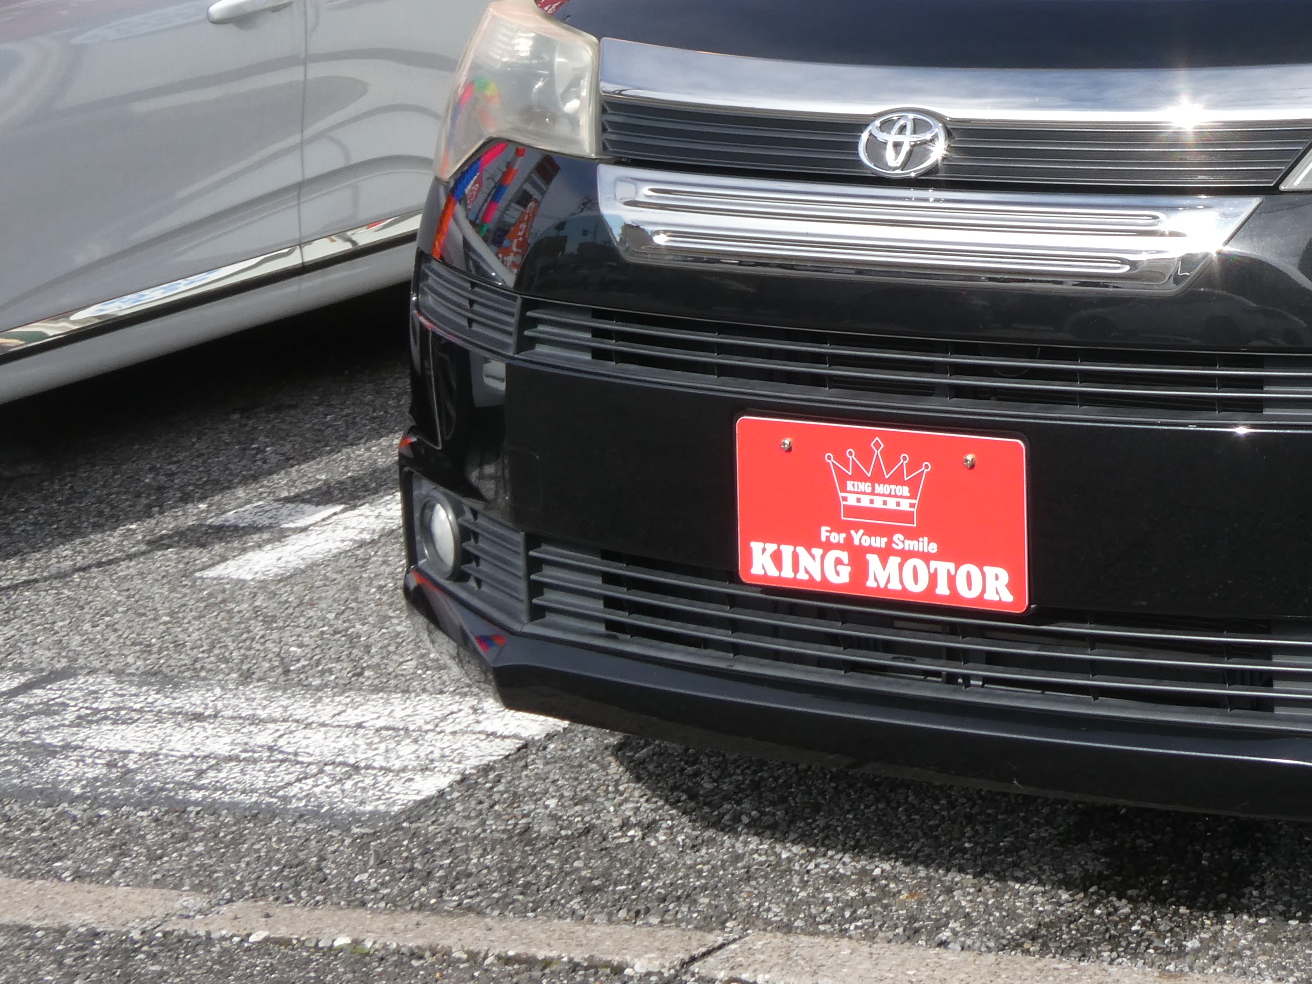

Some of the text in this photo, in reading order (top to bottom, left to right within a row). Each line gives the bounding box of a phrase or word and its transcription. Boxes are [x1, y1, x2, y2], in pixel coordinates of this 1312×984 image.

[846, 480, 910, 497] KING MOTOR
[820, 526, 938, 554] For Your Smile
[750, 541, 1014, 602] KING MOTOR
